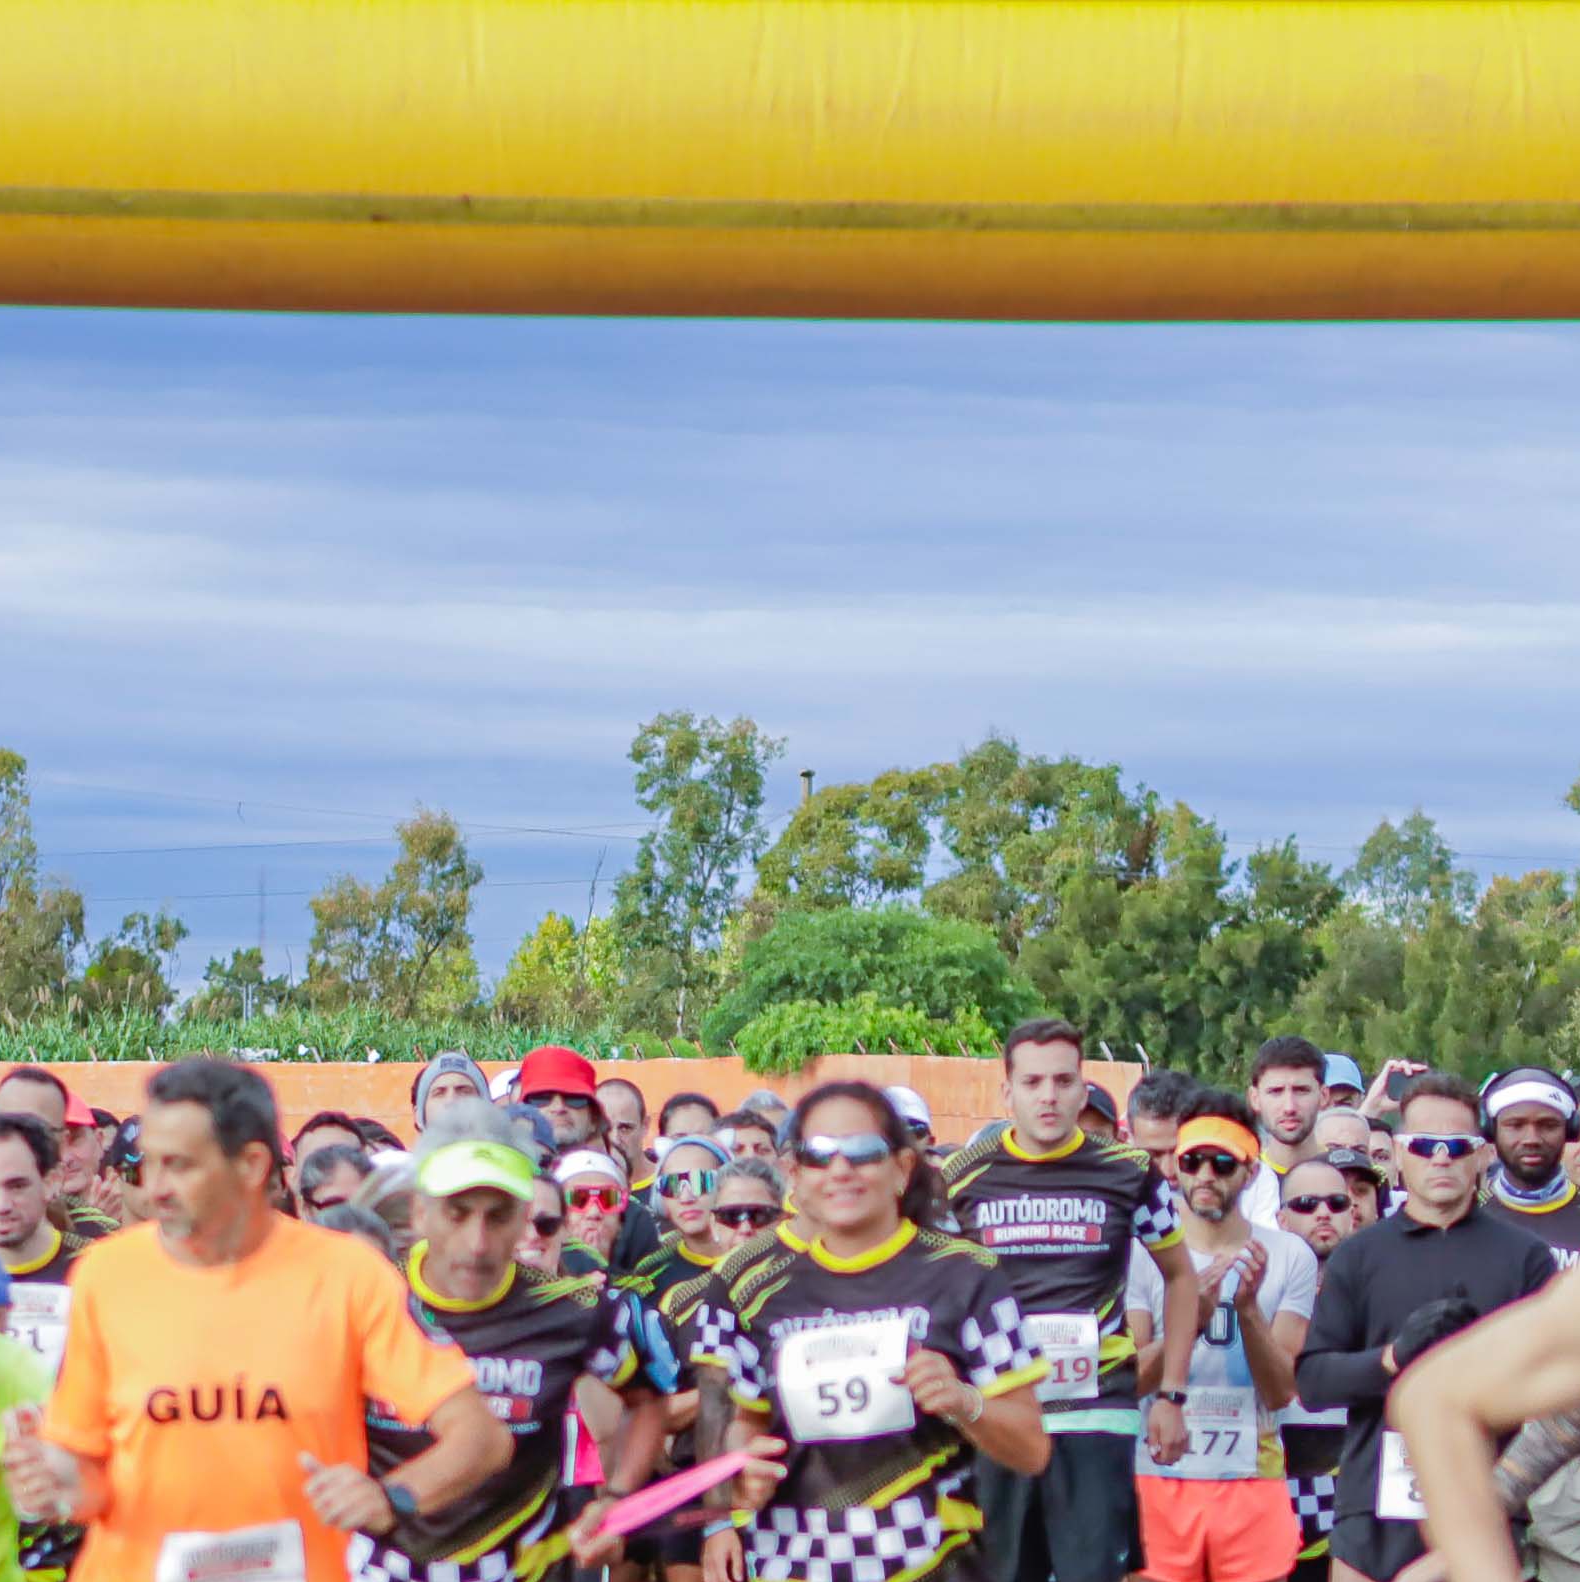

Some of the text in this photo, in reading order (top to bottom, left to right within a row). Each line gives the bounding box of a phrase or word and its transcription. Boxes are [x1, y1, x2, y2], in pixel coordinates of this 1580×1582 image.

[976, 1193, 1106, 1228] AUTÓDROMO
[994, 1224, 1086, 1243] RUNNING RACE
[1052, 1356, 1092, 1383] 19
[146, 1372, 287, 1423] GUÍA
[818, 1377, 868, 1416] 59
